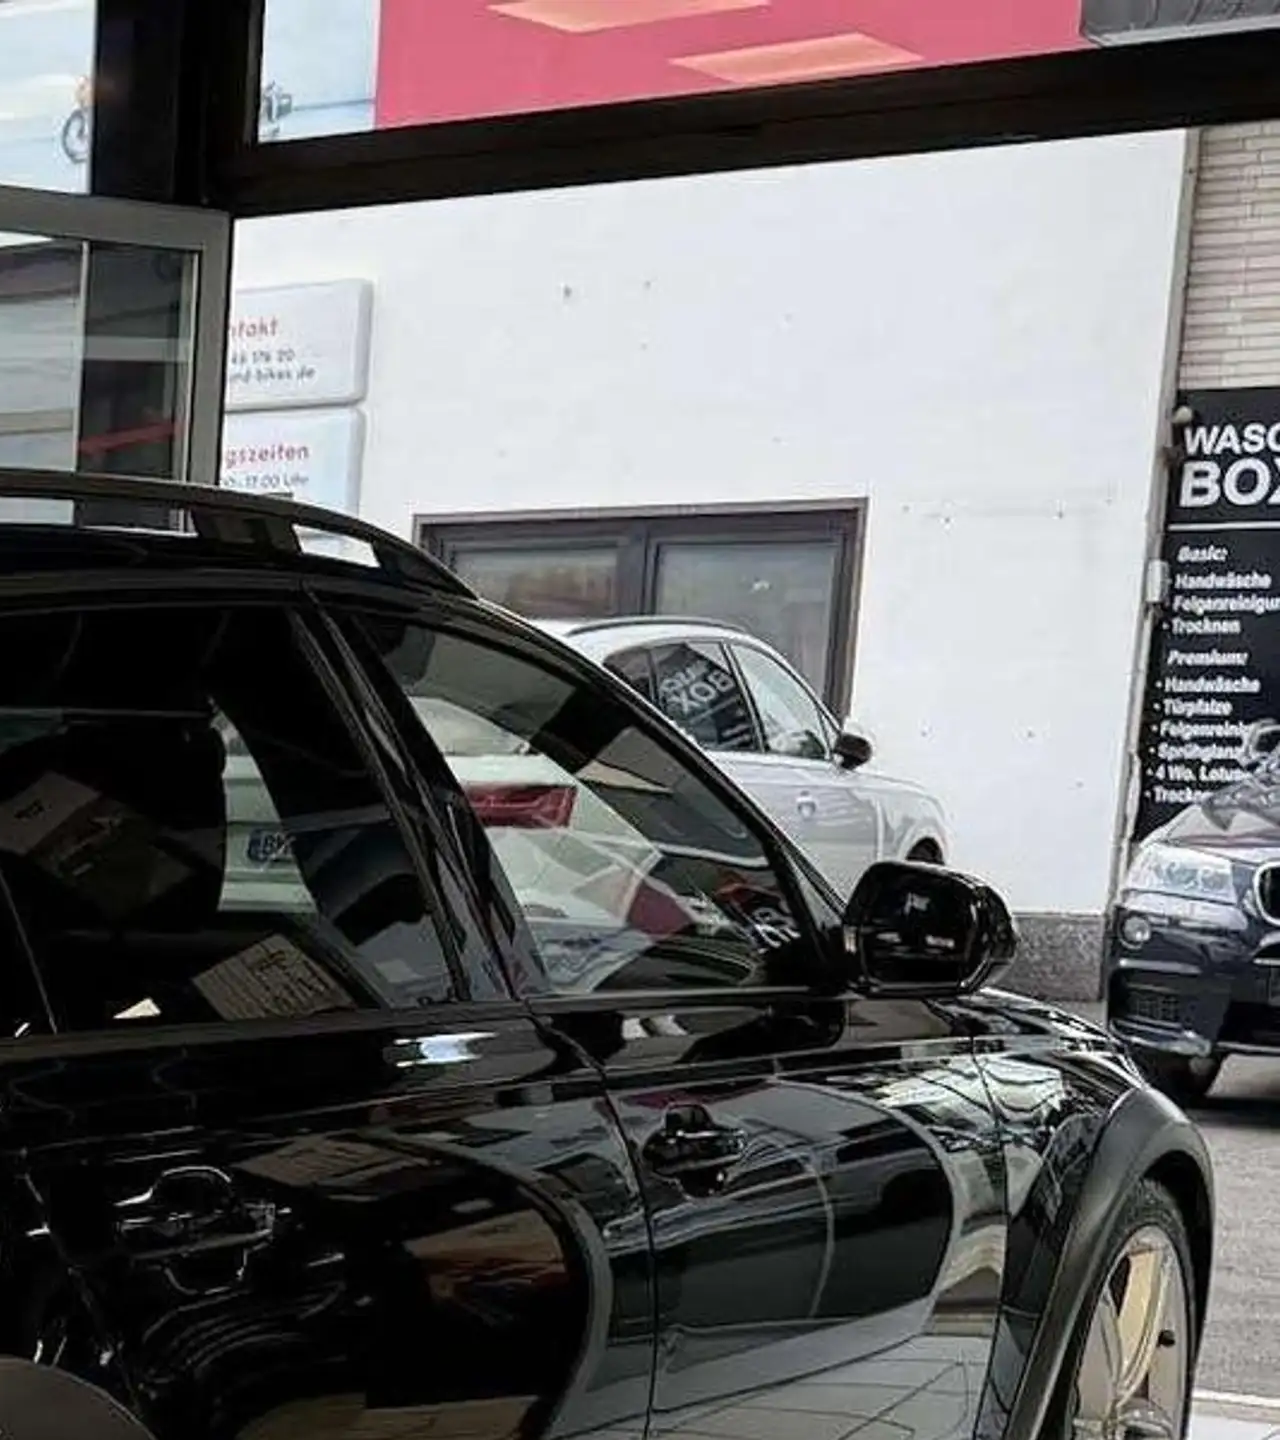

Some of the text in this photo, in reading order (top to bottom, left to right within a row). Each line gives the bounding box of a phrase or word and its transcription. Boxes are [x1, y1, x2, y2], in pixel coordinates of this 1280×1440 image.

[1179, 458, 1280, 508] BO
[1177, 544, 1228, 562] Basic:
[1175, 571, 1272, 589] Handwäsche
[1171, 616, 1241, 635] Trocknen
[1167, 649, 1249, 667] Premium:
[1164, 675, 1262, 693] Handwäsche
[1155, 764, 1166, 780] 4
